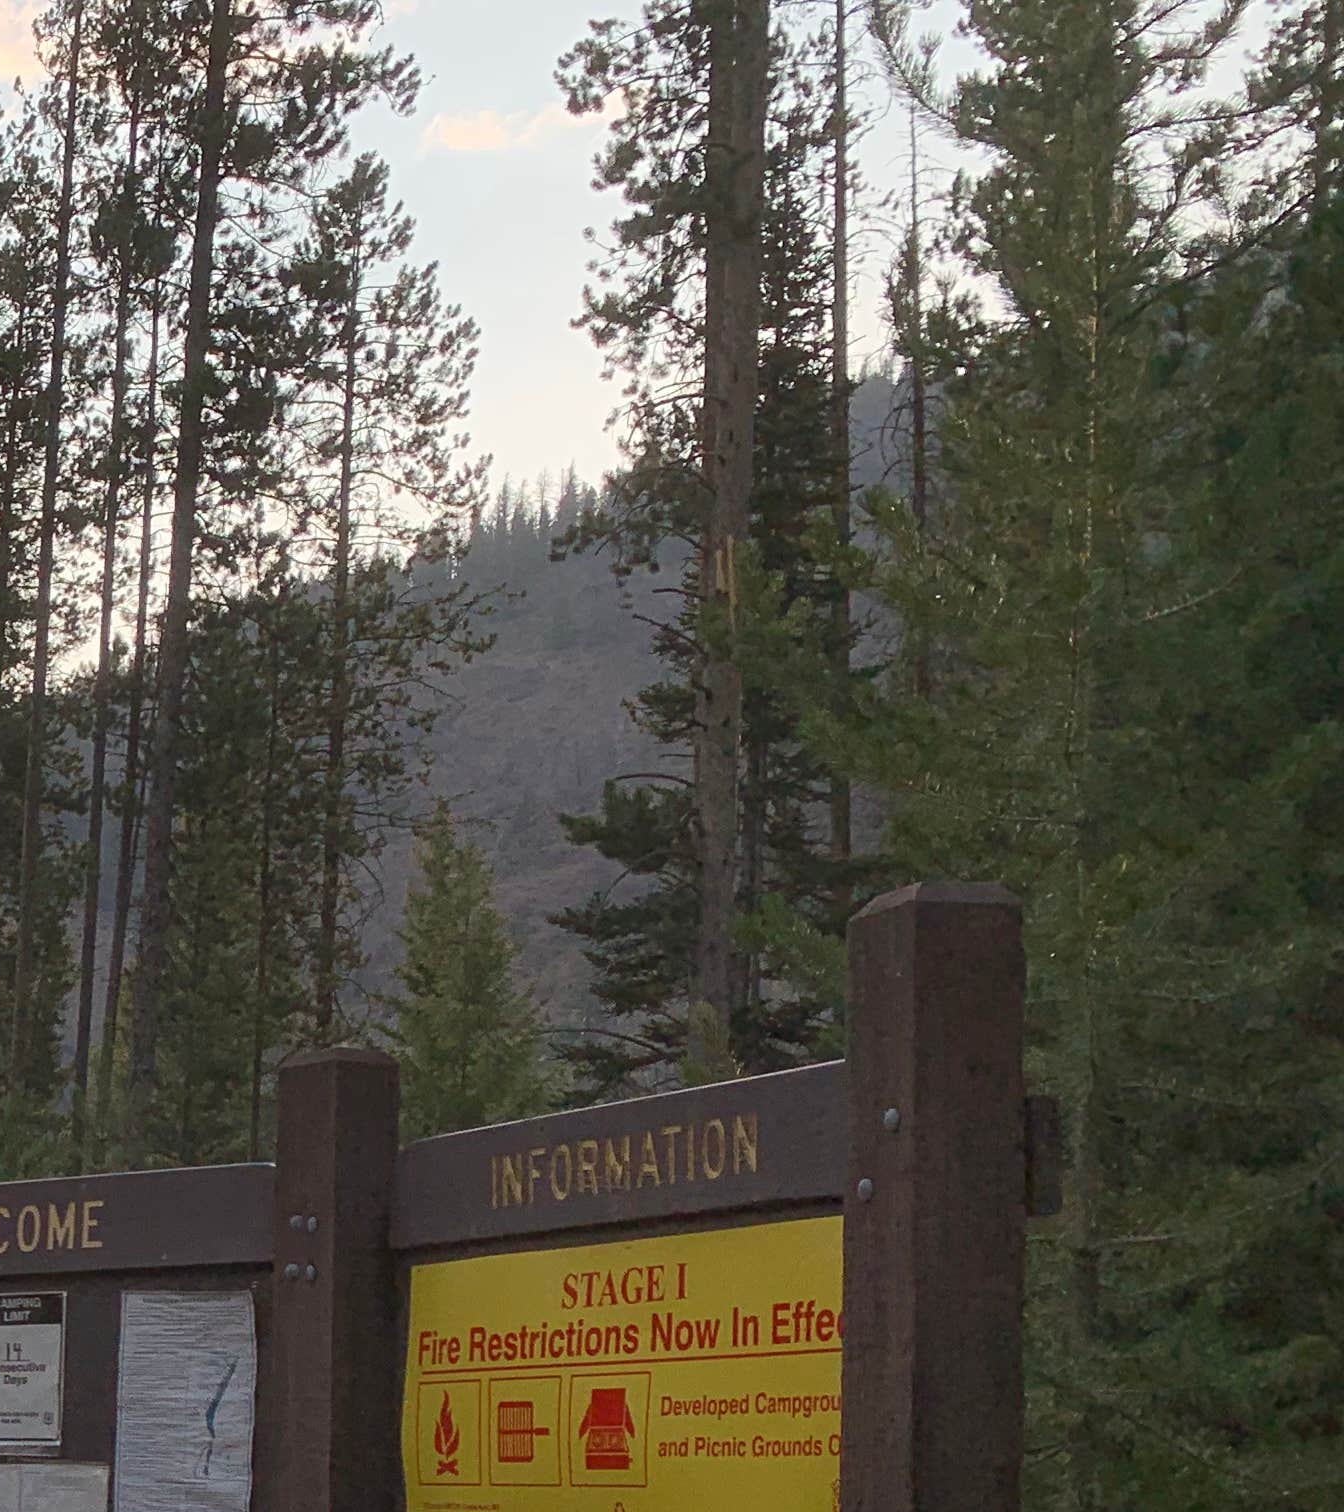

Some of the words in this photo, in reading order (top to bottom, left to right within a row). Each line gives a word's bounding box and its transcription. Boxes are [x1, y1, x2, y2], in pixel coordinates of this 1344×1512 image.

[490, 1113, 758, 1210] INFORMATION
[561, 1265, 664, 1310] STAGE
[675, 1263, 688, 1300] I
[3, 1310, 32, 1322] LIMIT
[418, 1330, 461, 1366] Fire
[469, 1319, 640, 1362] Restrictions
[650, 1312, 720, 1352] Now
[731, 1306, 759, 1348] In
[3, 1374, 28, 1387] Days
[660, 1395, 750, 1420] Developed
[658, 1437, 689, 1457] and
[694, 1436, 747, 1457] Picnic
[752, 1434, 823, 1457] Grounds
